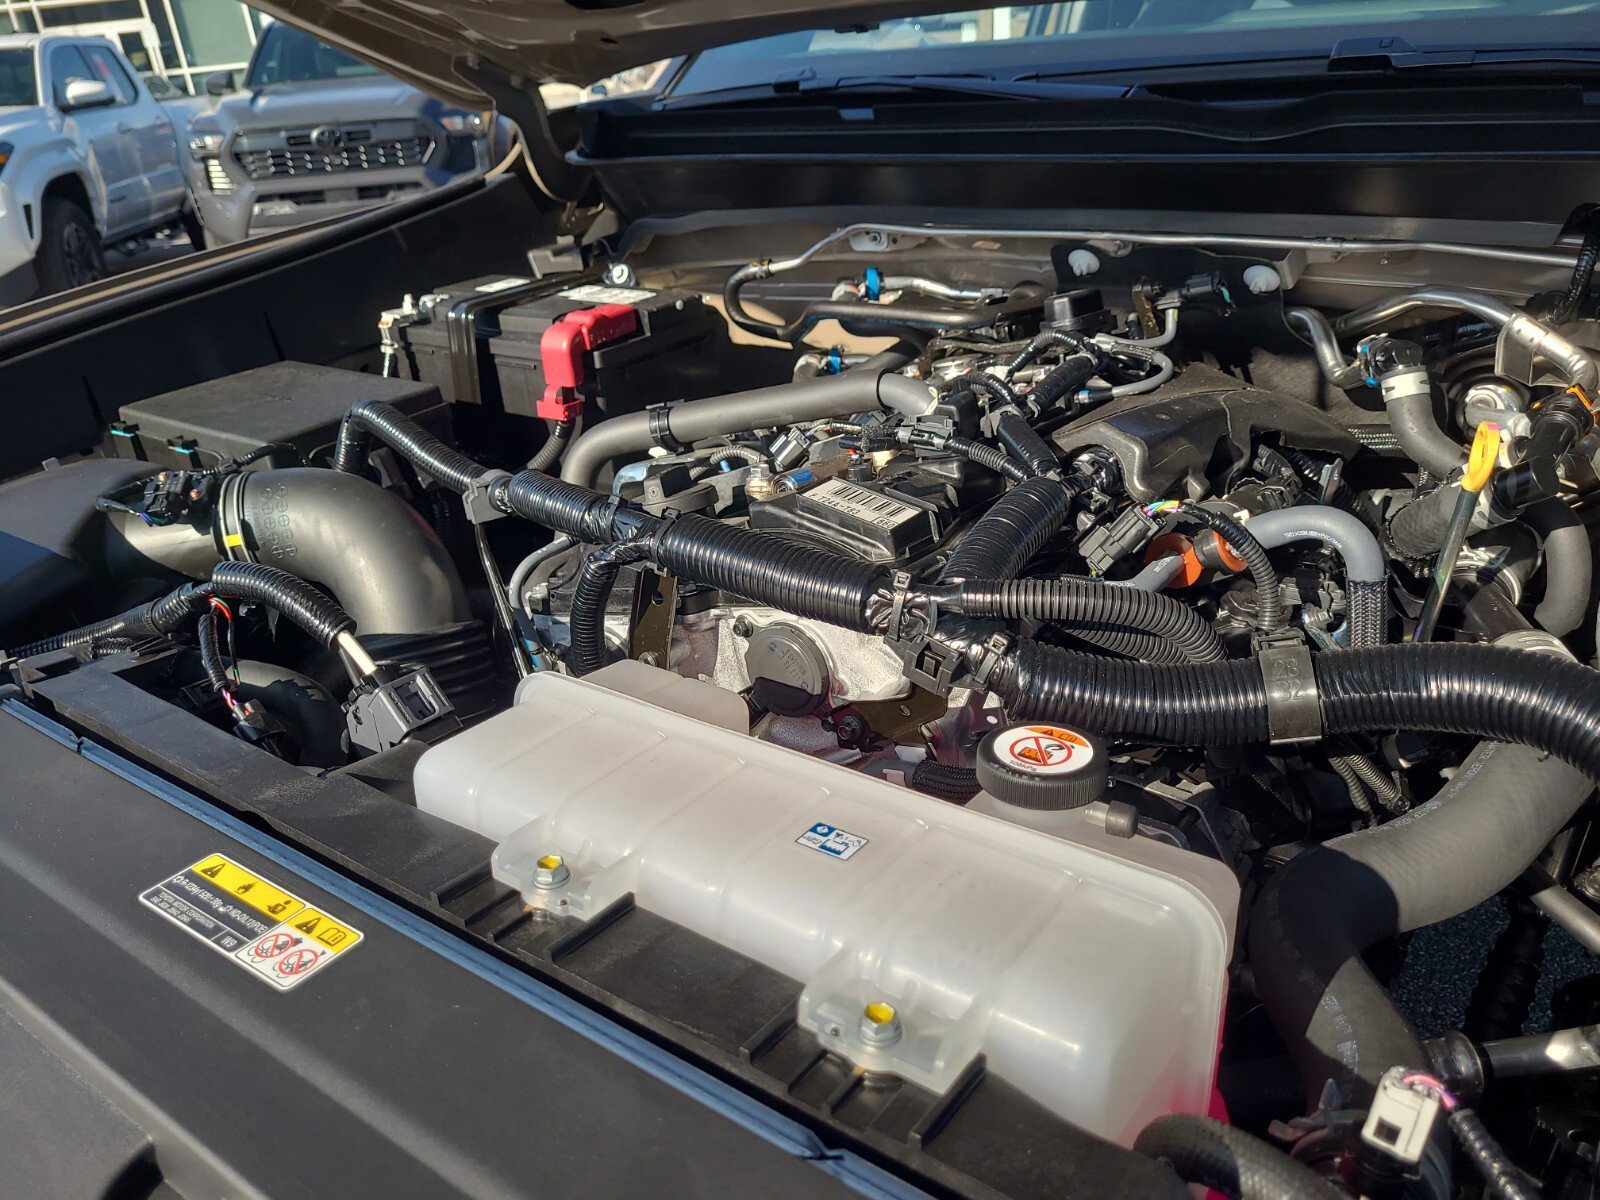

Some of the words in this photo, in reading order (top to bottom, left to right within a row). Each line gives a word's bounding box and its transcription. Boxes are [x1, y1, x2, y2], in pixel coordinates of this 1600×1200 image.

[1273, 657, 1300, 679] 28
[1277, 679, 1304, 702] 32
[1009, 759, 1037, 772] 108kPa
[186, 909, 216, 929] CORPORATION
